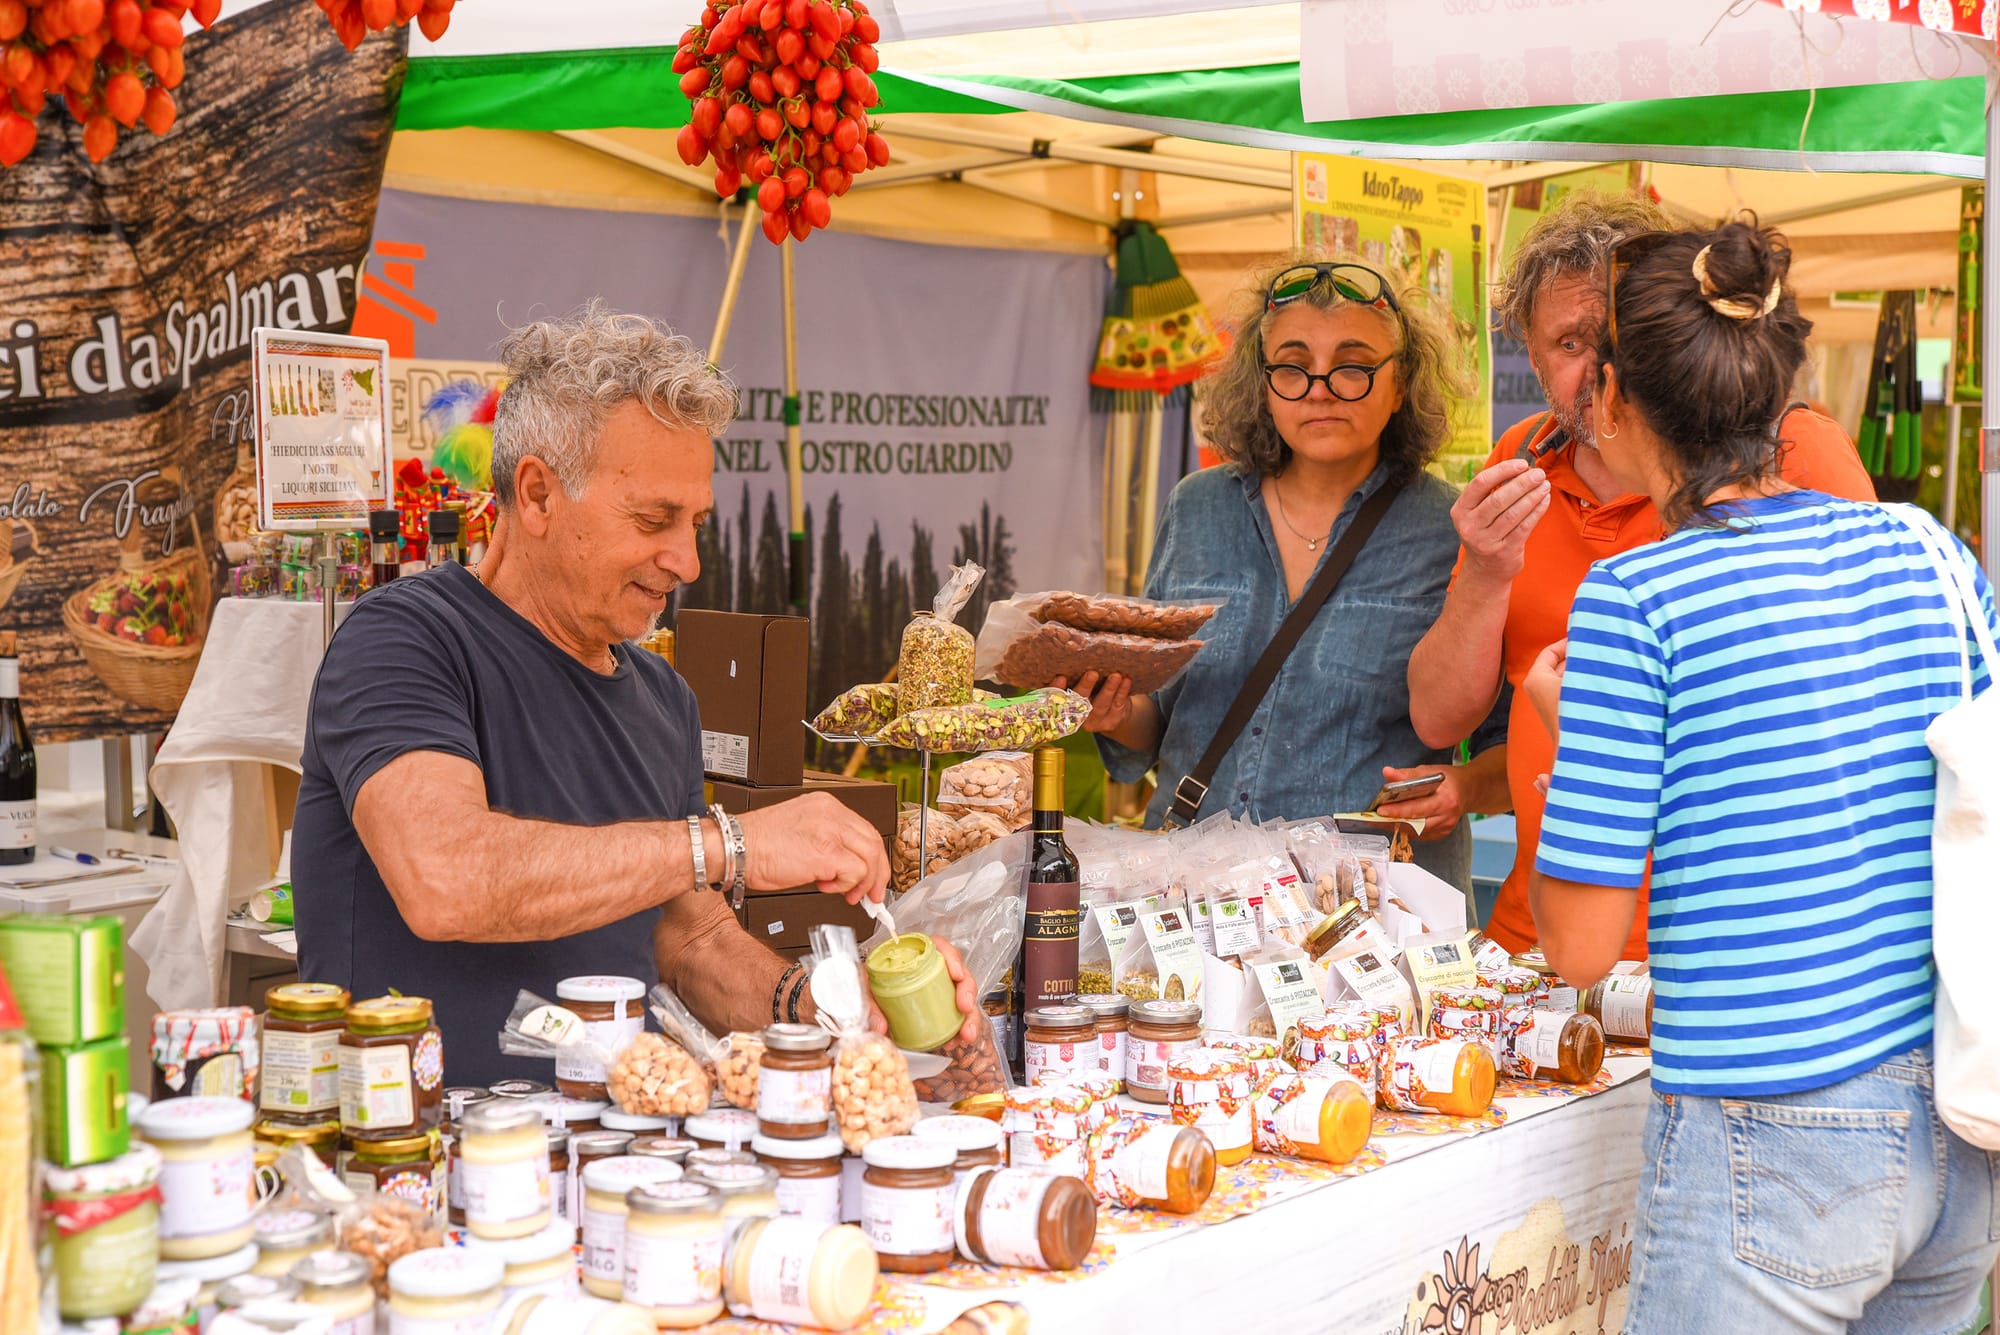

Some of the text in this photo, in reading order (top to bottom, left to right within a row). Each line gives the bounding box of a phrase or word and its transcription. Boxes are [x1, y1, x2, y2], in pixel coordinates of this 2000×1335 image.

[71, 315, 162, 394] da
[165, 264, 354, 389] Spalmar
[807, 391, 825, 423] E
[270, 445, 307, 457] HIEDICI
[713, 439, 771, 473] NEL
[308, 463, 338, 477] NOSTRI
[281, 481, 318, 495] LIQUORI
[1044, 978, 1074, 993] COTTO
[568, 1069, 583, 1078] 190
